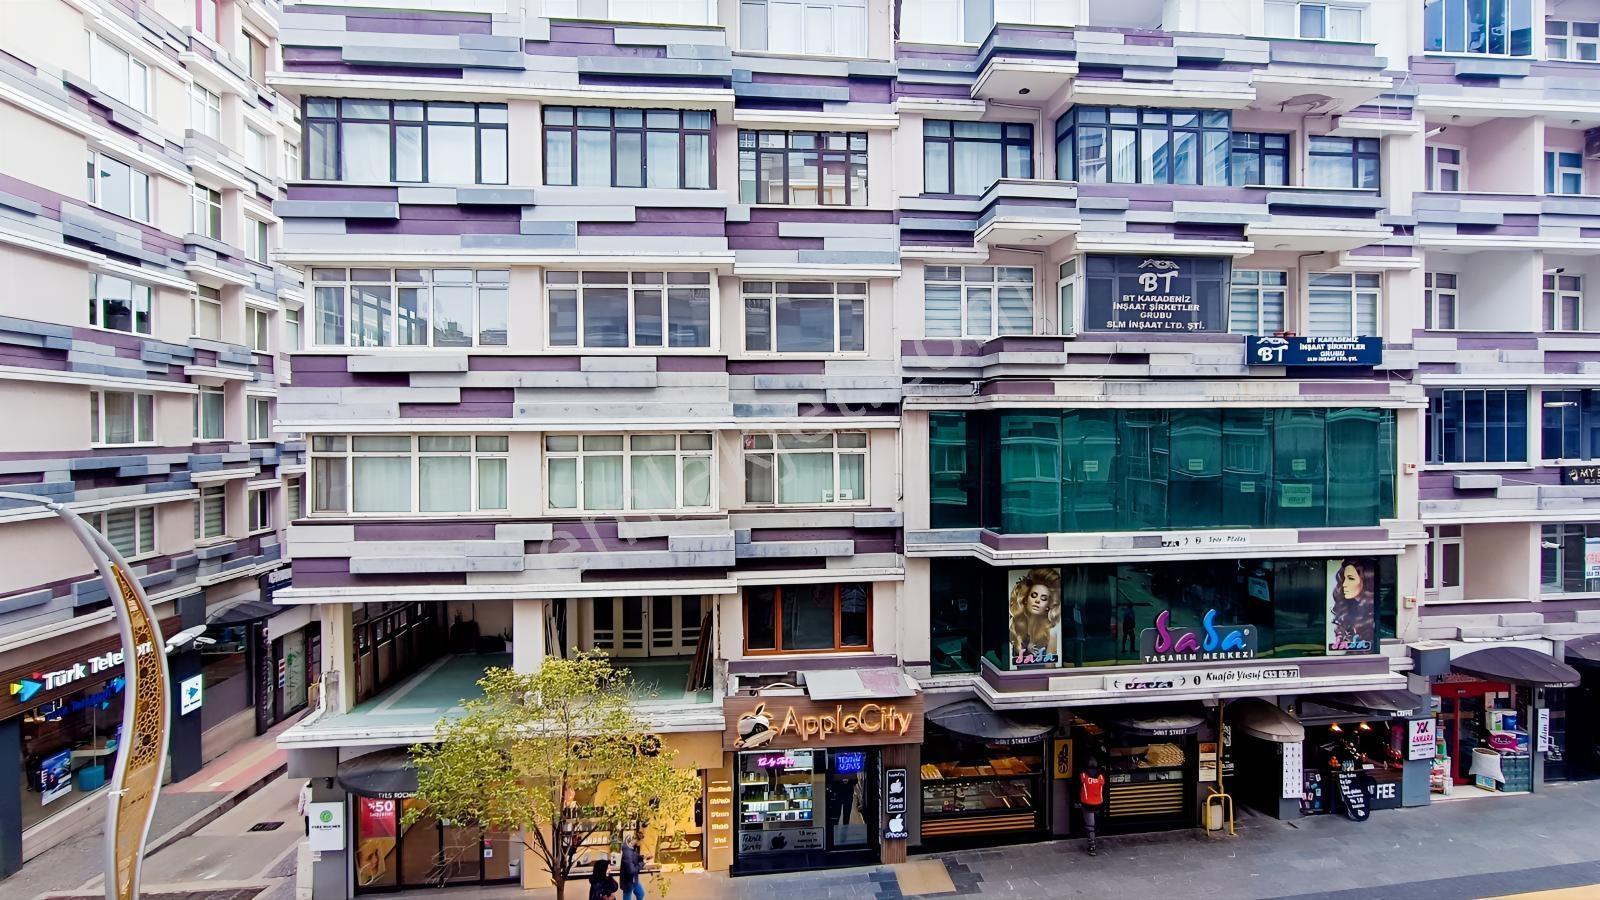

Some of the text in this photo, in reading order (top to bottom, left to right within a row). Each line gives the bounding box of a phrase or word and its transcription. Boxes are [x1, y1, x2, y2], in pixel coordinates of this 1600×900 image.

[1138, 271, 1179, 293] BT
[1112, 301, 1200, 312] İNŞAAT ŞİRKETLER
[1138, 294, 1192, 303] KARADENİZ
[1106, 320, 1126, 328] SLM
[1128, 320, 1162, 331] İNŞAAT
[1164, 321, 1185, 329] LTD.
[1257, 345, 1289, 362] BT
[1144, 648, 1254, 663] TASARIM MERKEZİ
[42, 662, 86, 691] Türk
[779, 703, 913, 741] AppleCity
